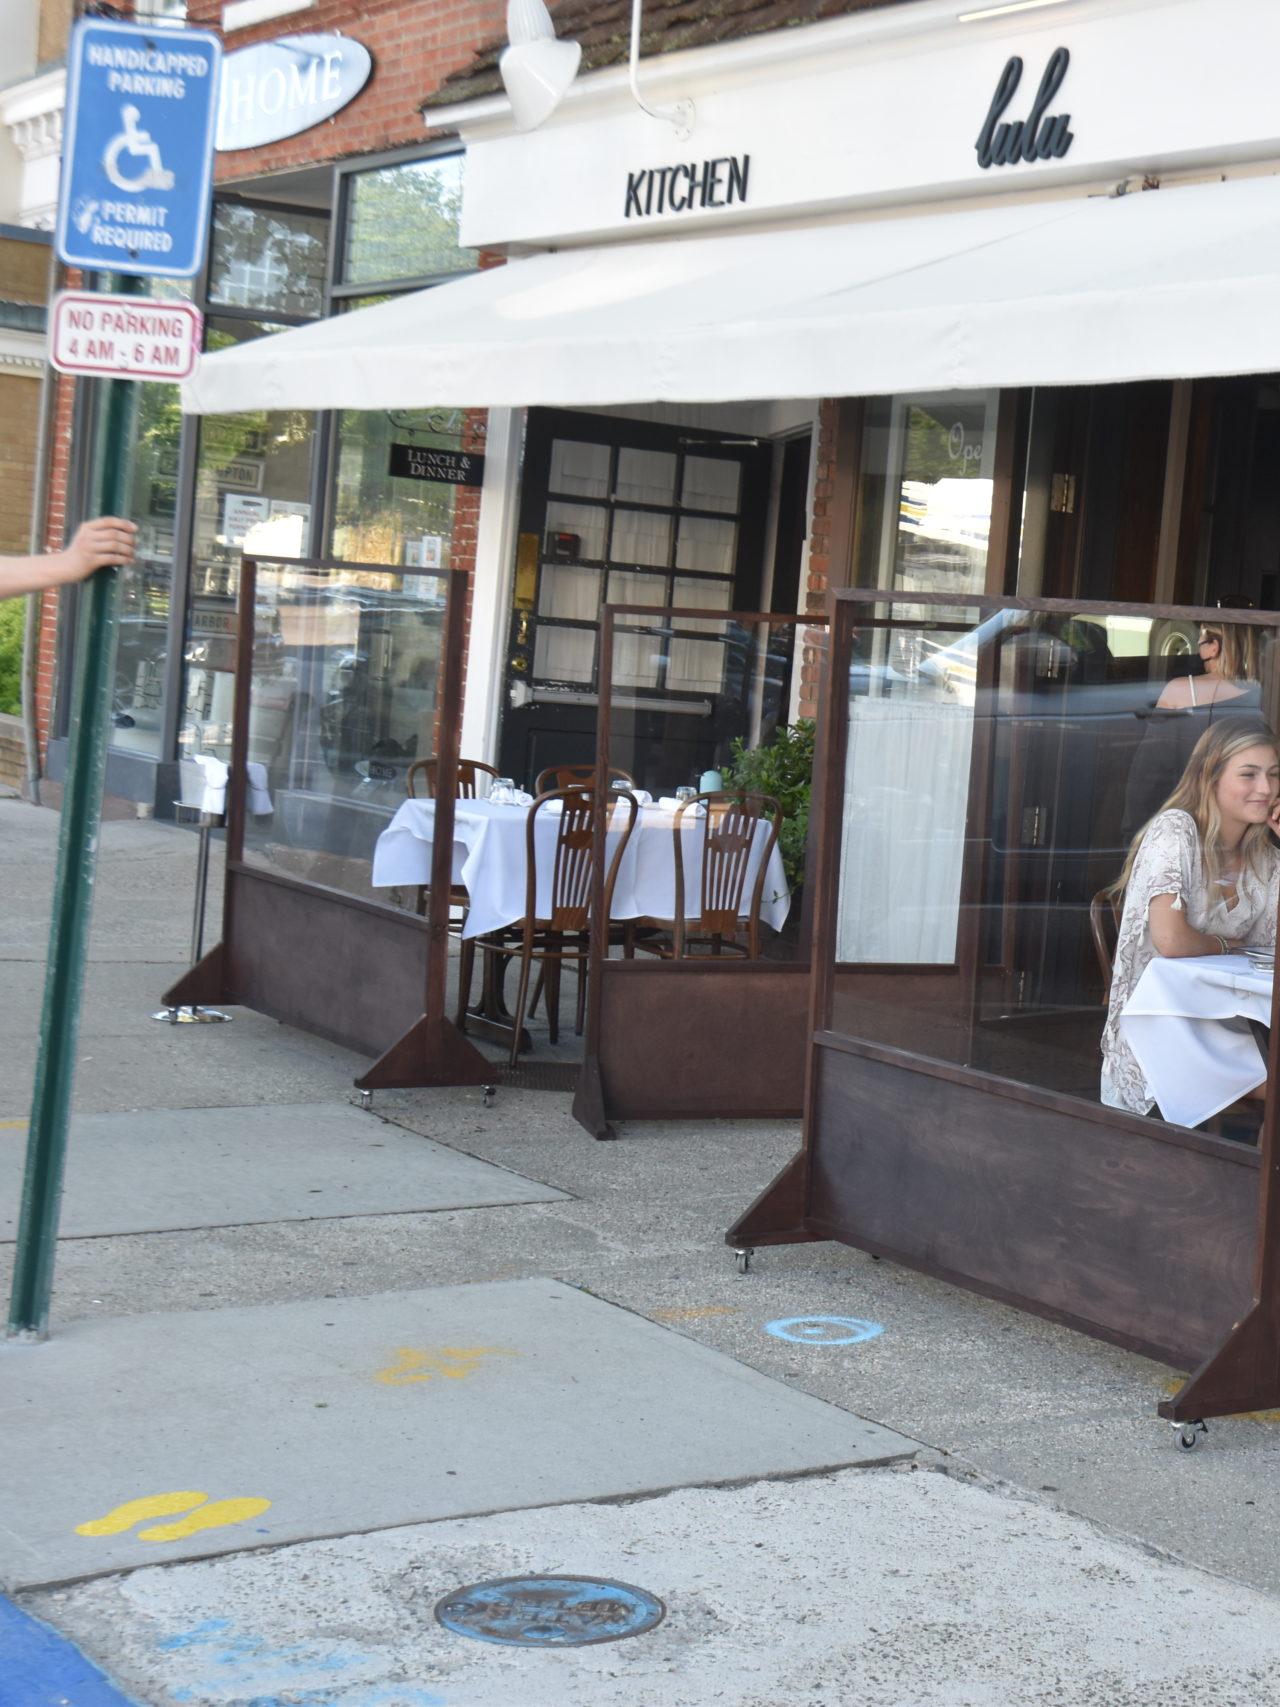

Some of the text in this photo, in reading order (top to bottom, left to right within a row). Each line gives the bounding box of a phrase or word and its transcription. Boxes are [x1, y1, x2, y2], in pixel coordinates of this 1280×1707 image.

[88, 43, 208, 78] HANDICAPPED
[108, 71, 186, 99] PARKING
[230, 49, 343, 123] HOME
[974, 46, 1074, 169] lulu
[624, 154, 750, 218] KITCHEN
[101, 200, 169, 228] PERMIT
[91, 223, 173, 253] REQUIRED
[68, 310, 184, 338] NO PARKING
[68, 338, 79, 357] 4
[85, 339, 115, 361] AM
[133, 343, 145, 363] 6
[151, 345, 180, 367] AM
[407, 449, 471, 470] LUNCH &
[948, 421, 982, 477] Ope
[410, 462, 466, 481] DINNER
